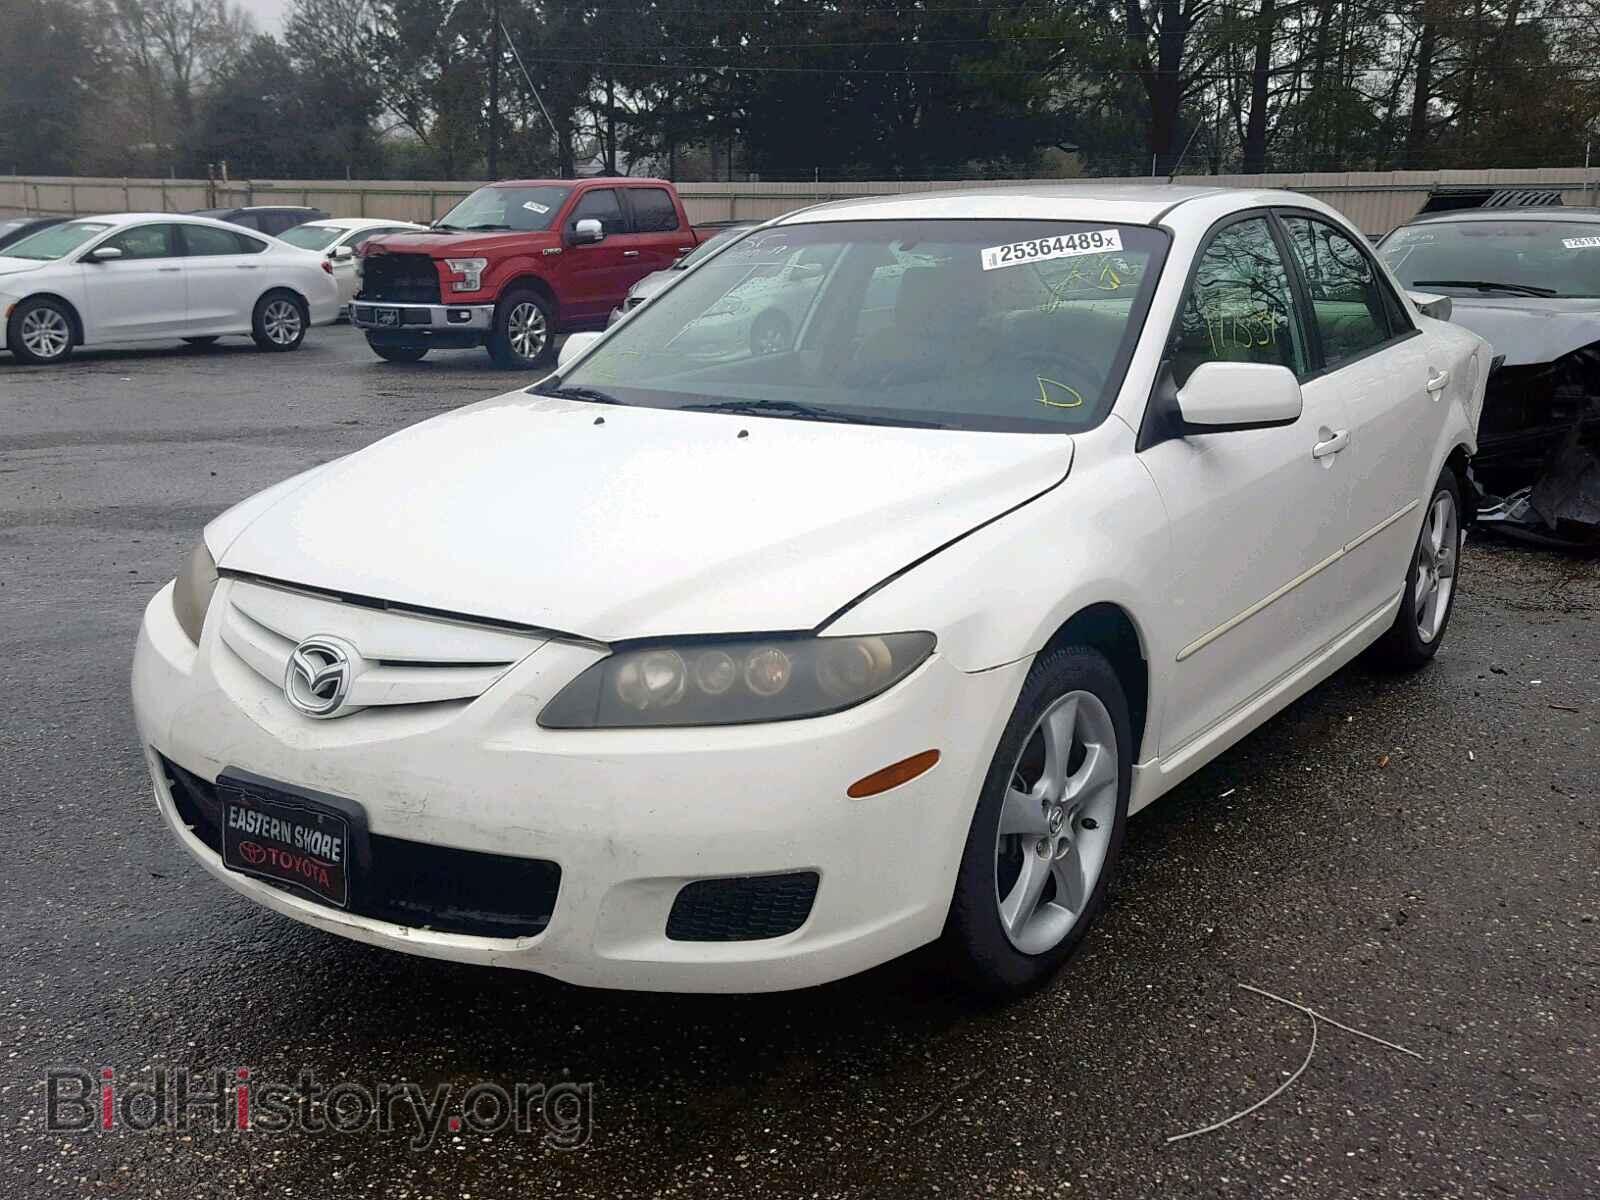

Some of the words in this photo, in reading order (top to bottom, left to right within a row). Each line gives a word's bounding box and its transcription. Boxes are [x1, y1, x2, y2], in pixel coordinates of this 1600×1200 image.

[229, 805, 291, 844] EASTERN
[294, 825, 342, 862] SHORE
[267, 847, 330, 887] TOYOTA
